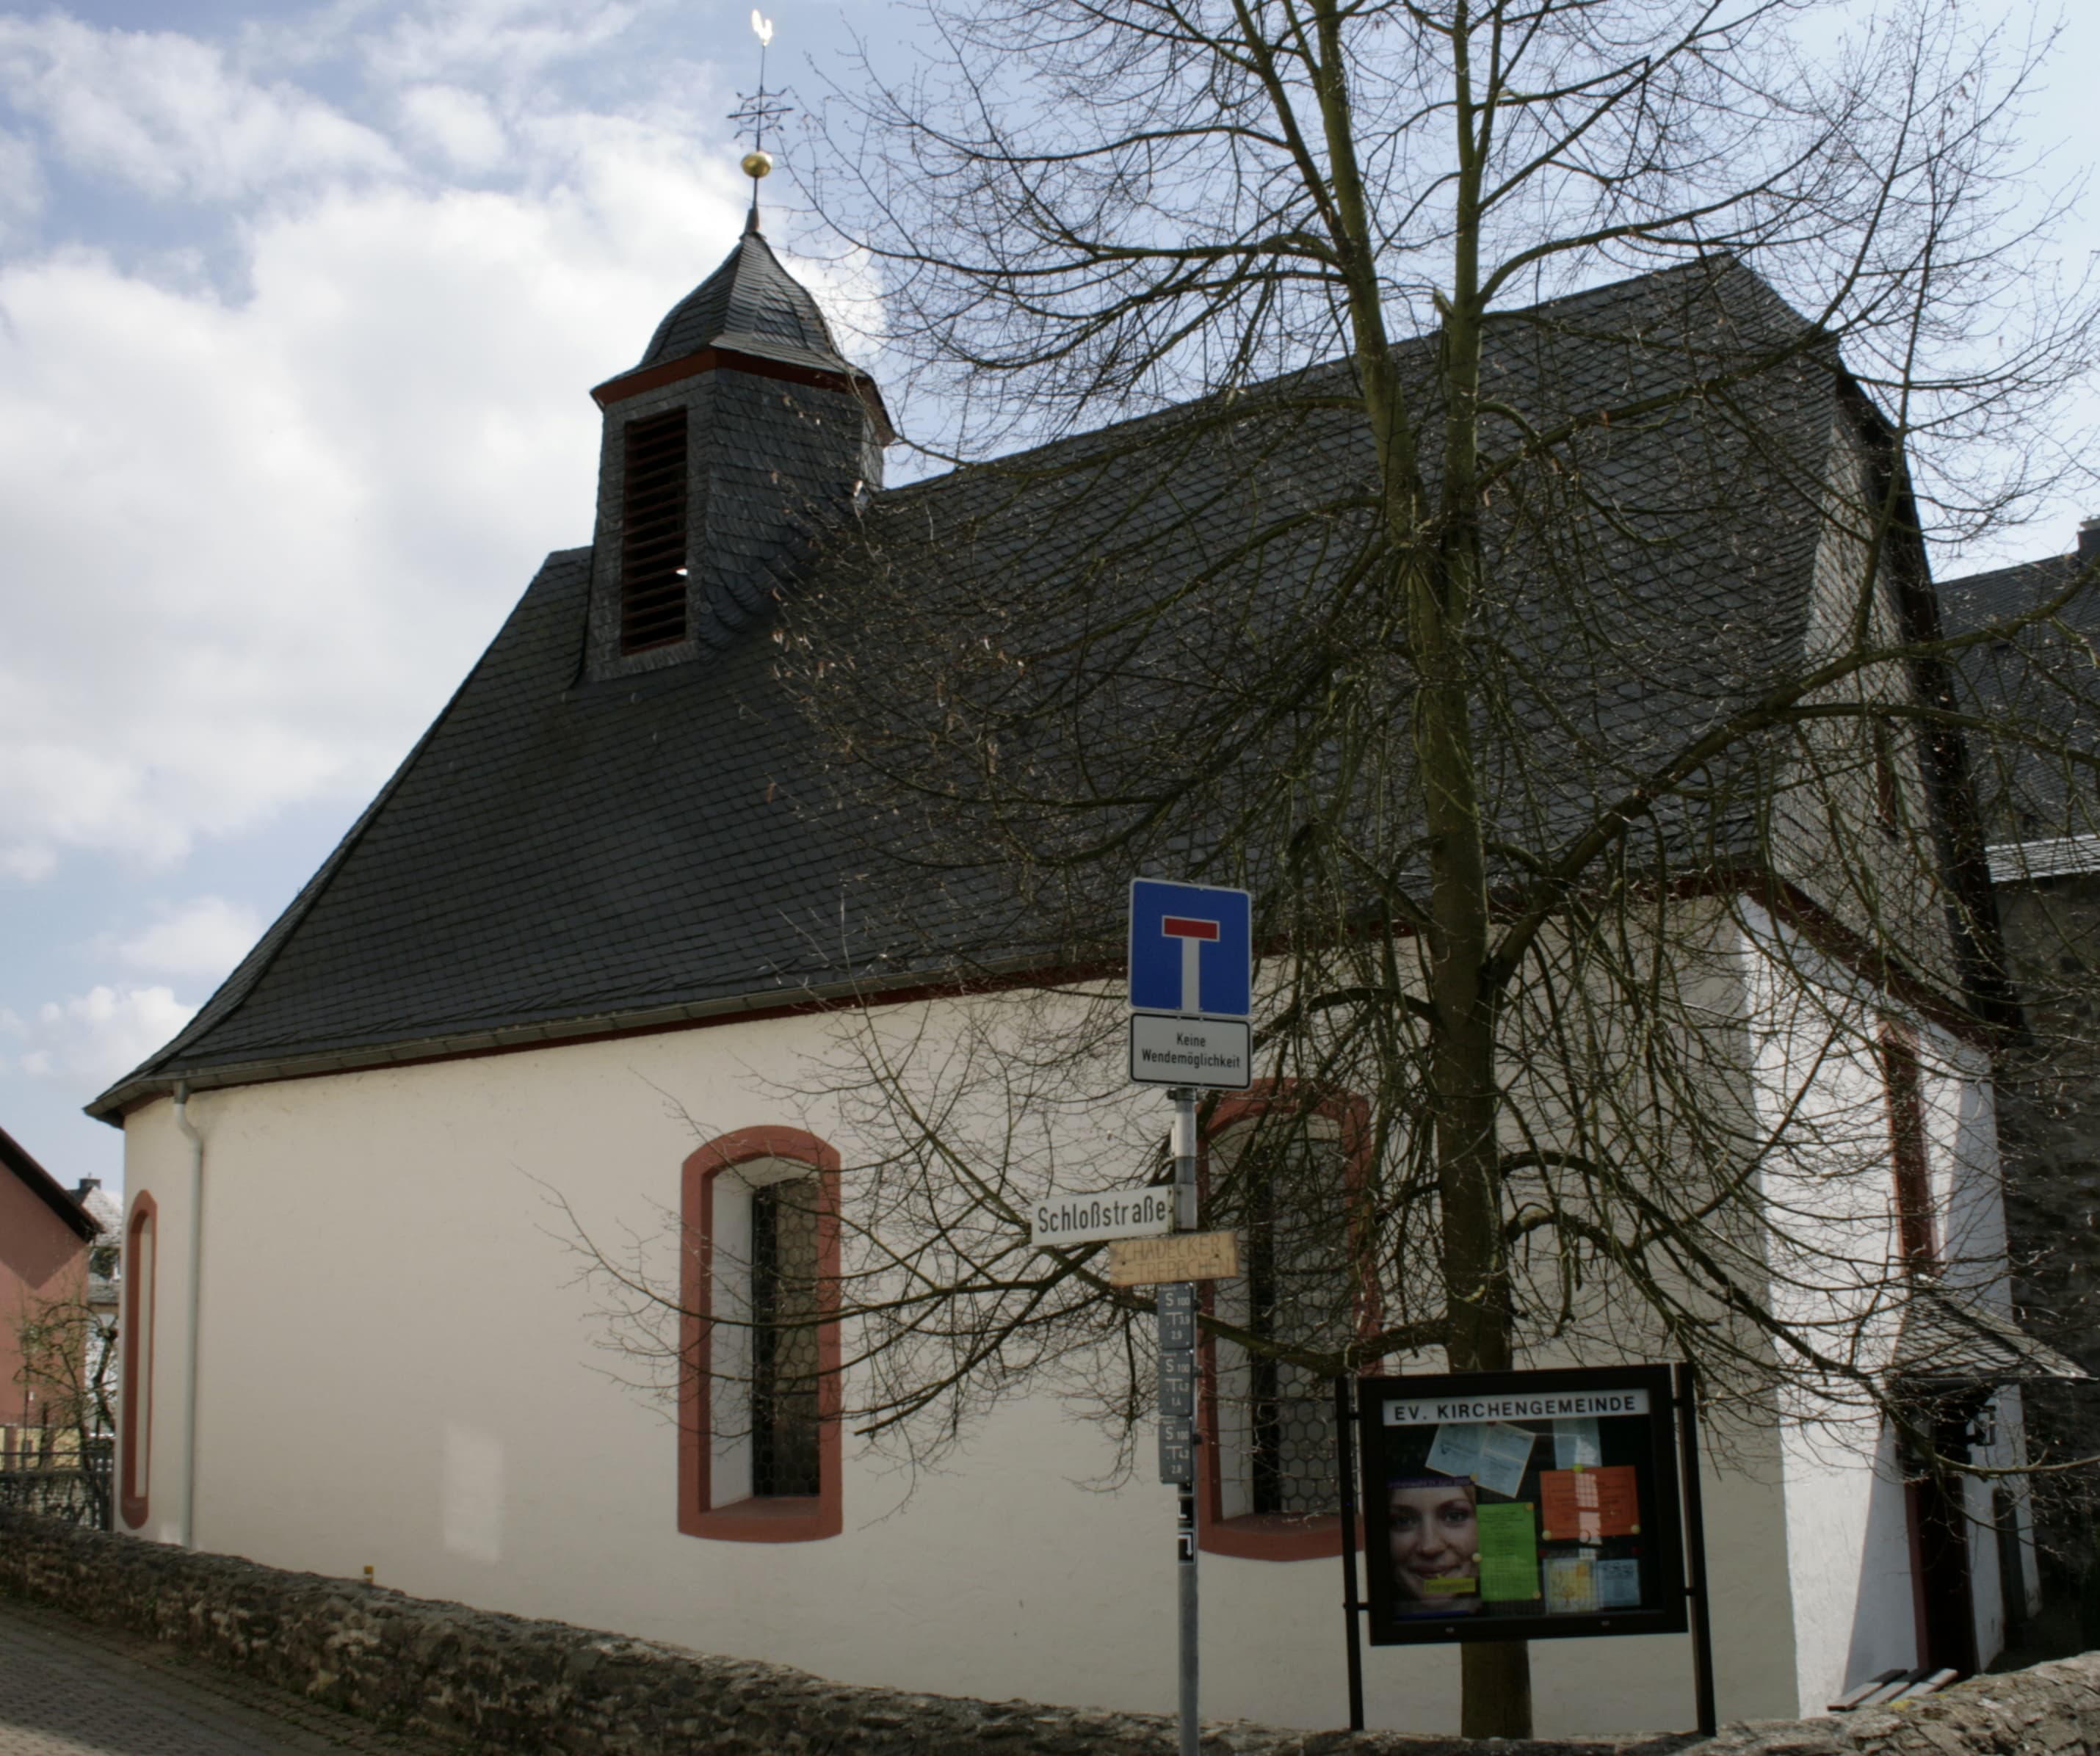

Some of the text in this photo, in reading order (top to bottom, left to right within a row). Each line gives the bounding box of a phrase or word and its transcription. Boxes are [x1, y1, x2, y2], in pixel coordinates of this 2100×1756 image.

[1176, 1032, 1206, 1047] Keine
[1142, 1048, 1240, 1069] Wendemöglichkeit
[1038, 1195, 1166, 1233] Schloßstraße
[1136, 1256, 1231, 1282] TREPPCHEN
[1166, 1291, 1174, 1307] S
[1166, 1358, 1174, 1373] S
[1394, 1396, 1636, 1421] EV. KIRCHENGEMEINDE
[1166, 1426, 1174, 1440] S
